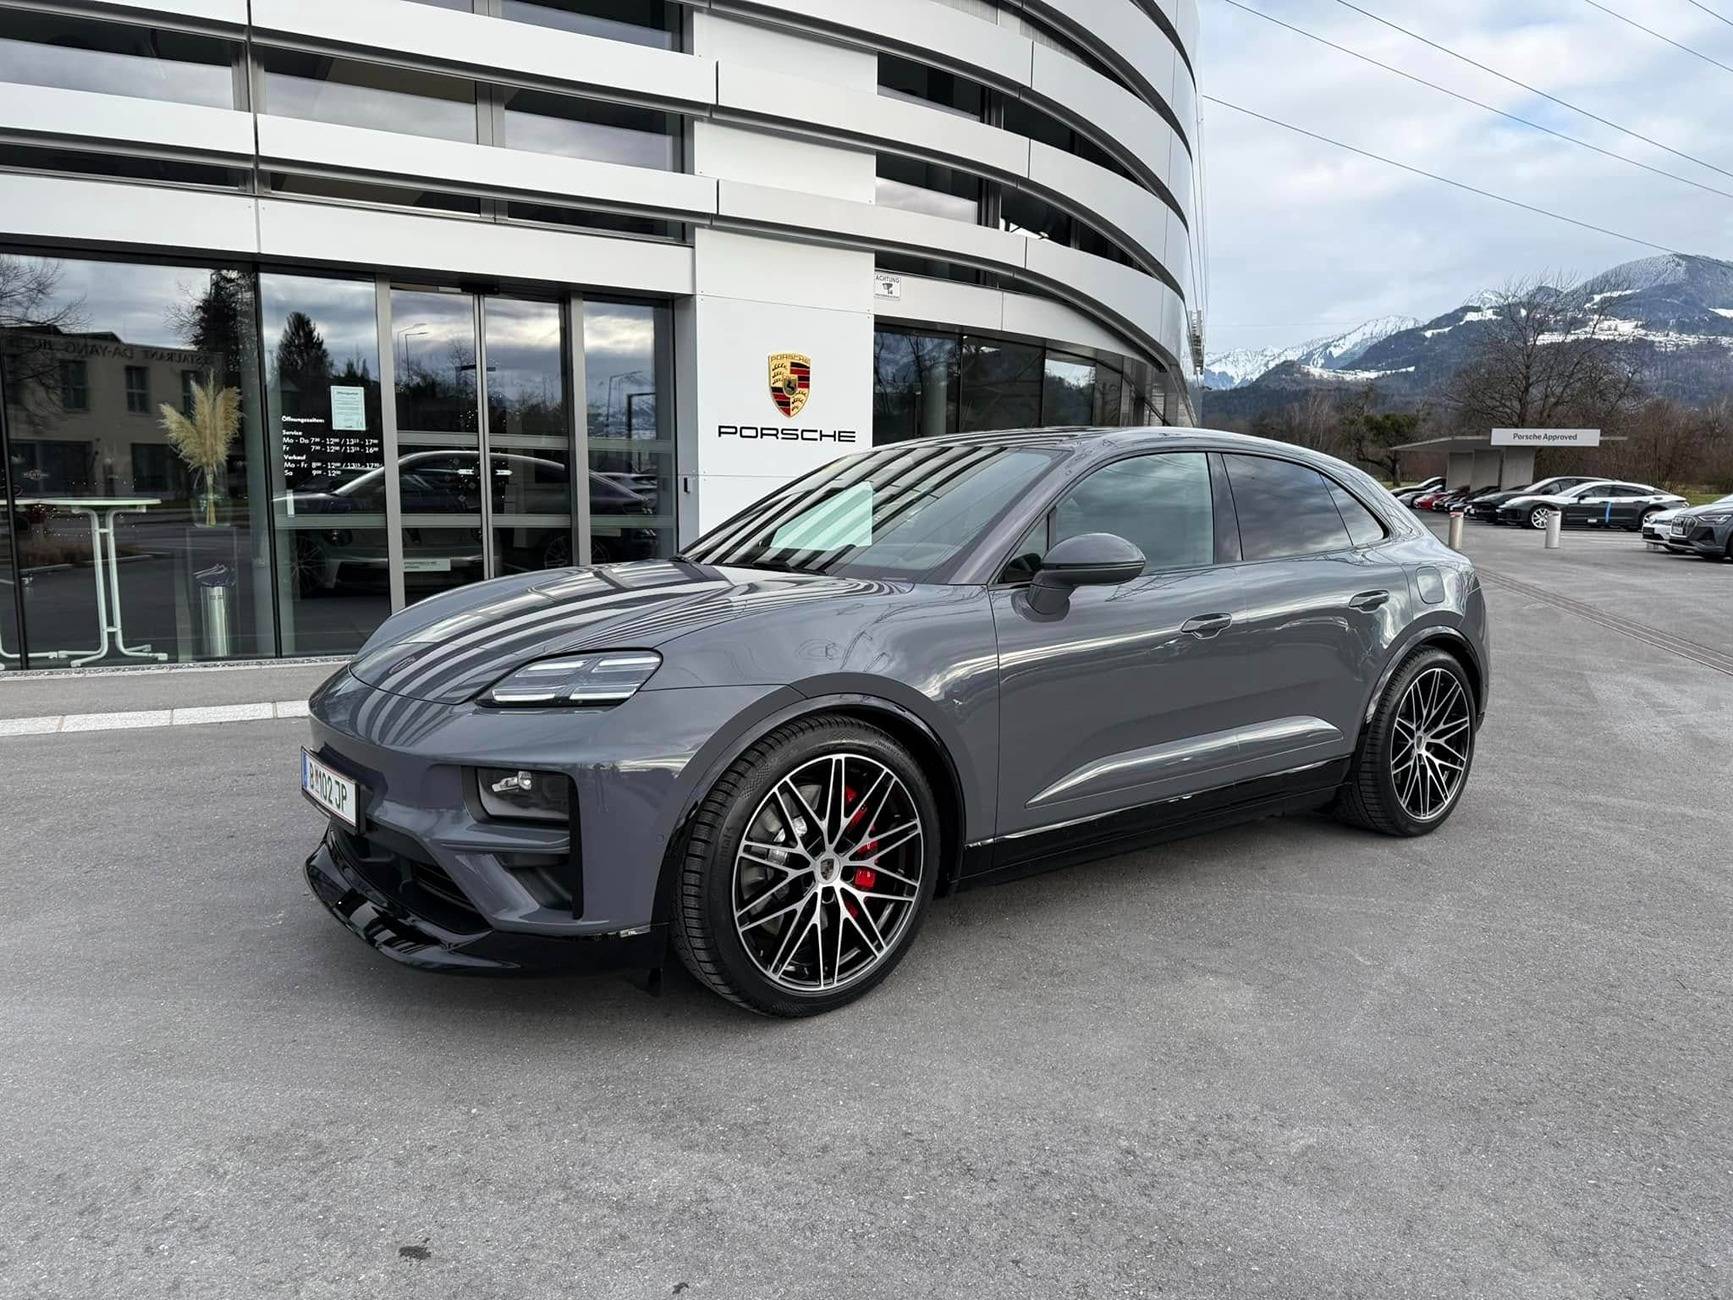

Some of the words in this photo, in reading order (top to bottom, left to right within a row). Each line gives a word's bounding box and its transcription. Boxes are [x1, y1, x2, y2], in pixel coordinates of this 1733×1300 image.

[718, 425, 856, 442] PORSCHE
[1512, 432, 1541, 440] Porsche
[1543, 433, 1578, 442] Approved
[335, 780, 347, 812] JP
